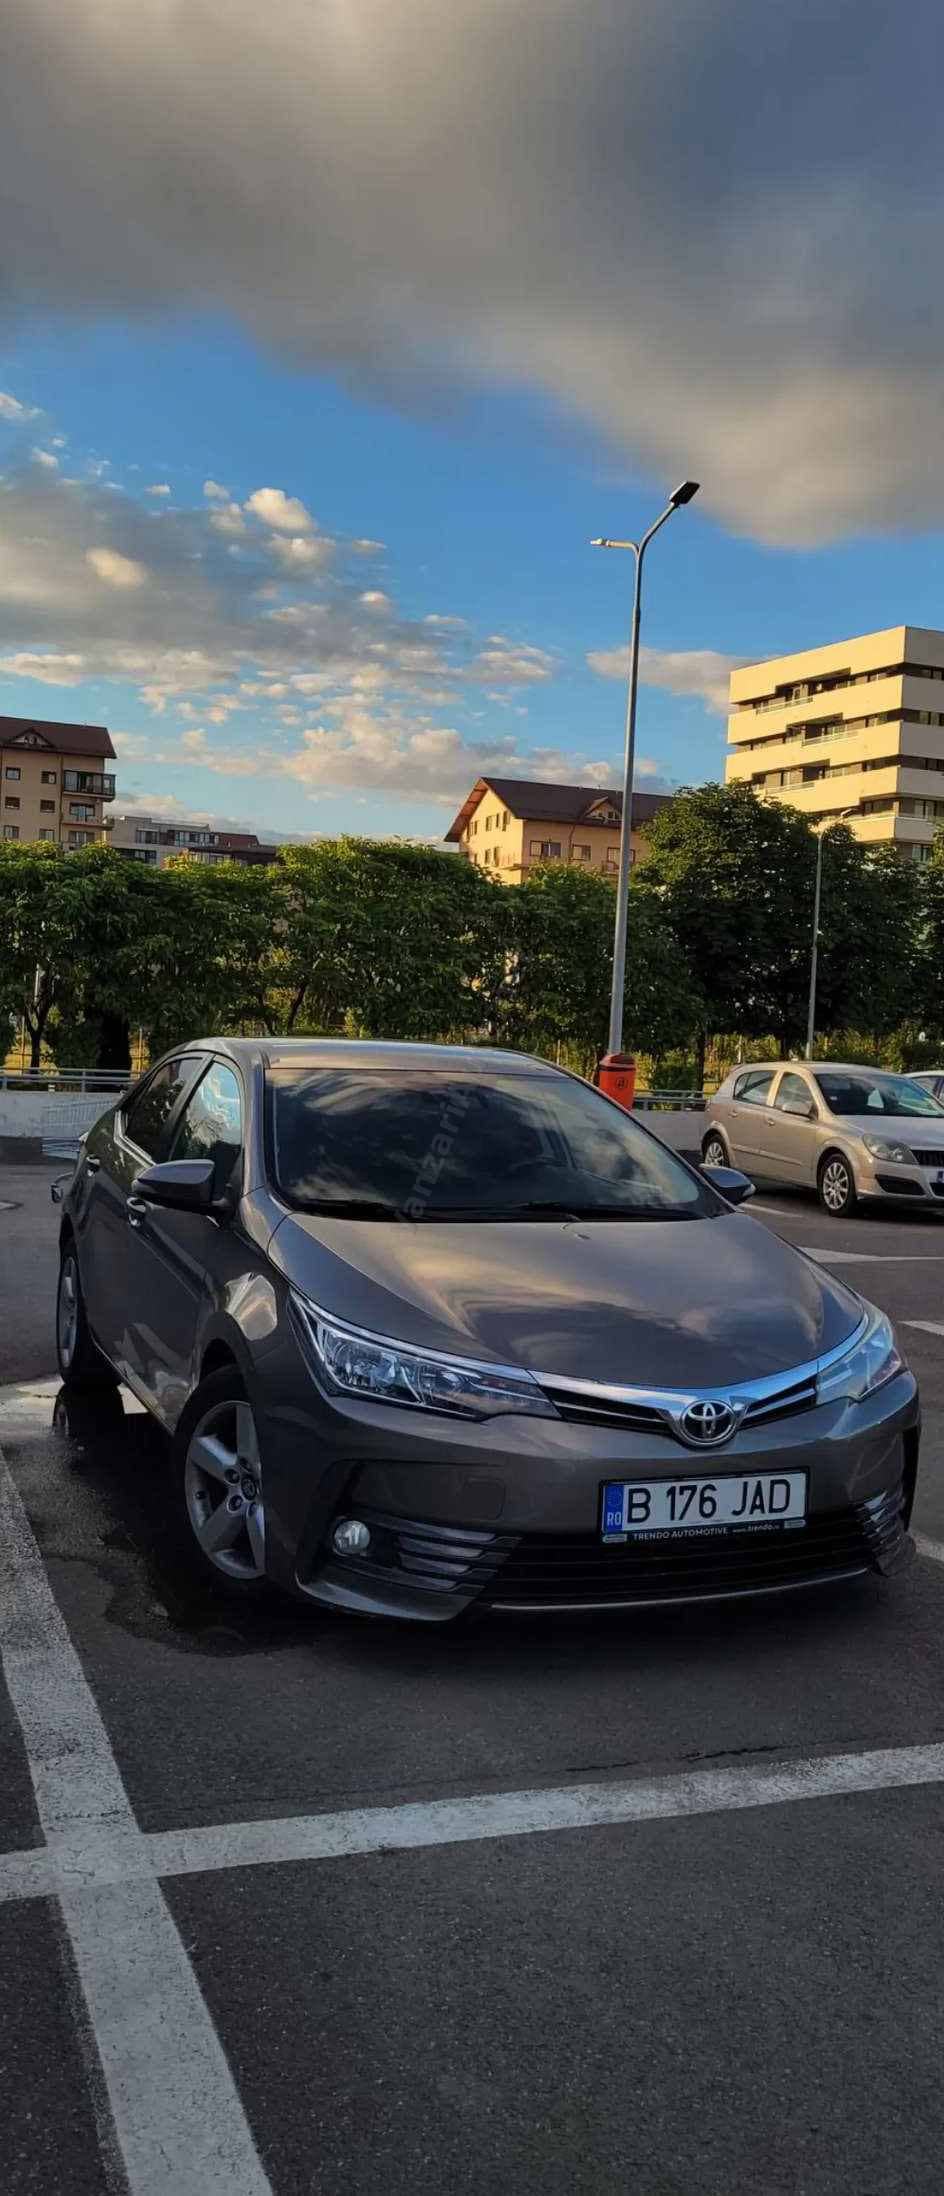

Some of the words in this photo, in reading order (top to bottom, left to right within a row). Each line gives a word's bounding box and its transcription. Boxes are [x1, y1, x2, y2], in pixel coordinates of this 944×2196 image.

[627, 1487, 651, 1524] B
[666, 1484, 717, 1521] 176
[731, 1479, 791, 1516] JAD
[607, 1511, 622, 1527] RO
[633, 1531, 670, 1542] TRENDO
[671, 1527, 728, 1539] AUTOMOTIVE
[732, 1524, 780, 1533] .trendo.
